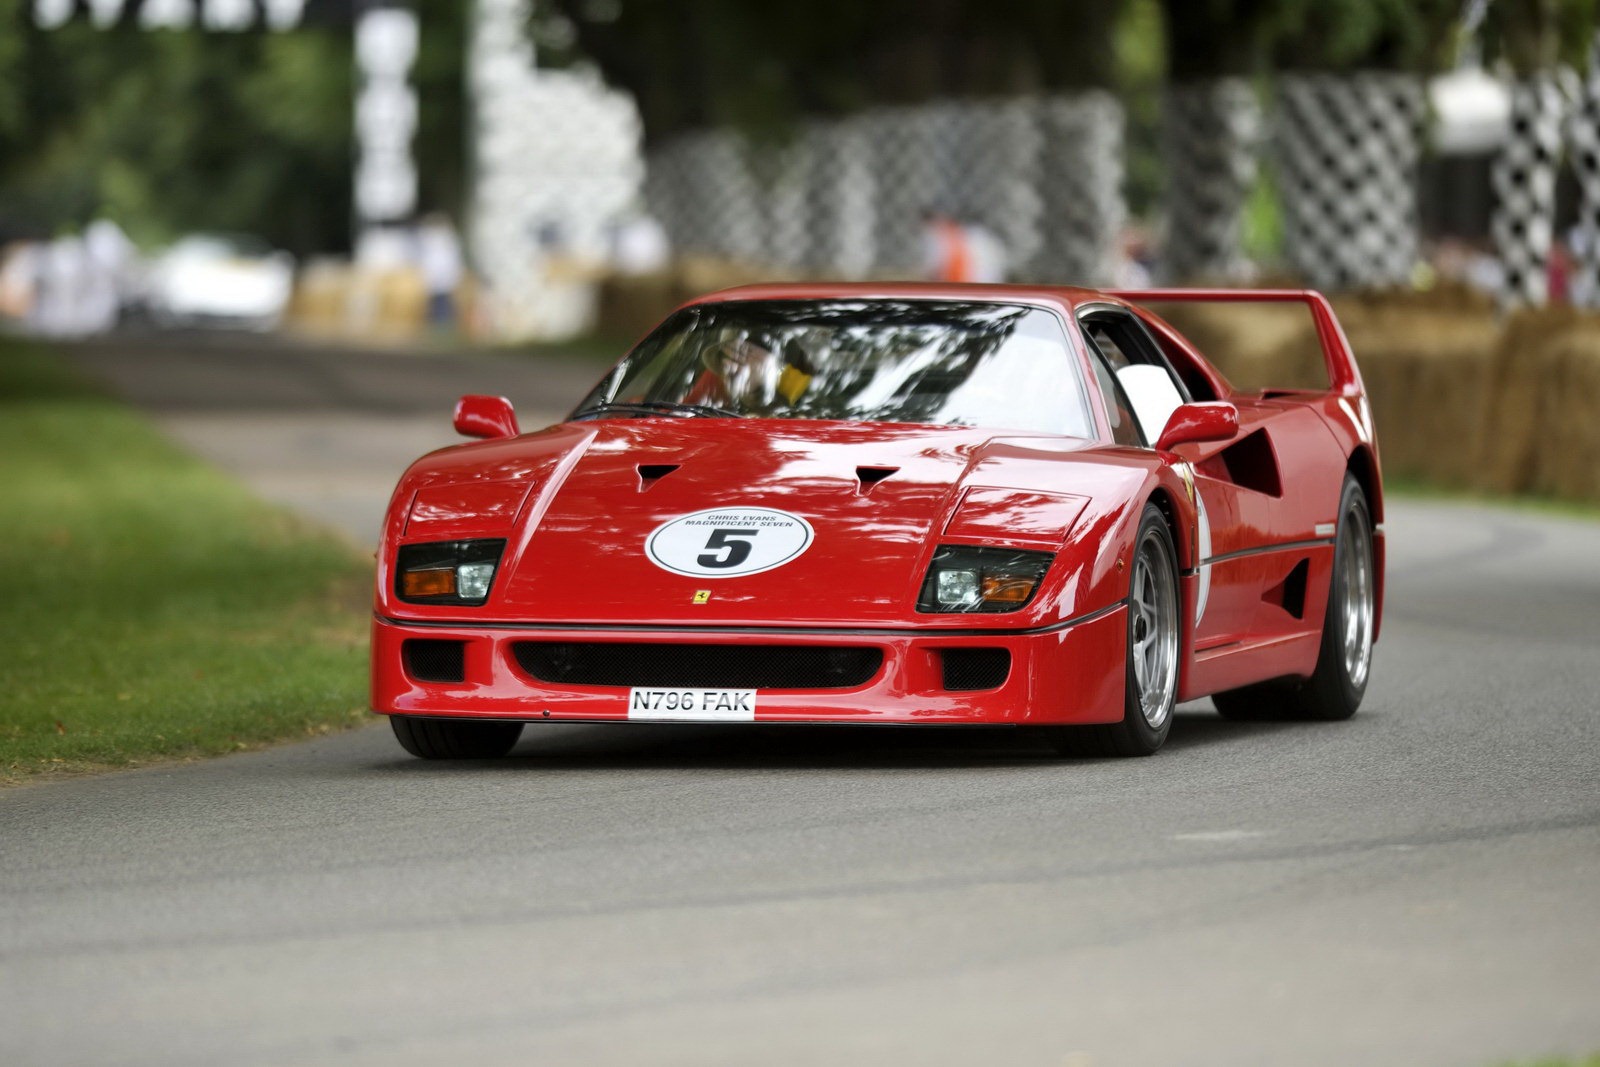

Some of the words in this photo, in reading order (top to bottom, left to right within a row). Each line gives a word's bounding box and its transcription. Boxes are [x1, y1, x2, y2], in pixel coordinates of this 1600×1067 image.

[696, 528, 760, 568] 5
[633, 691, 694, 711] N796
[702, 692, 751, 711] FAK
